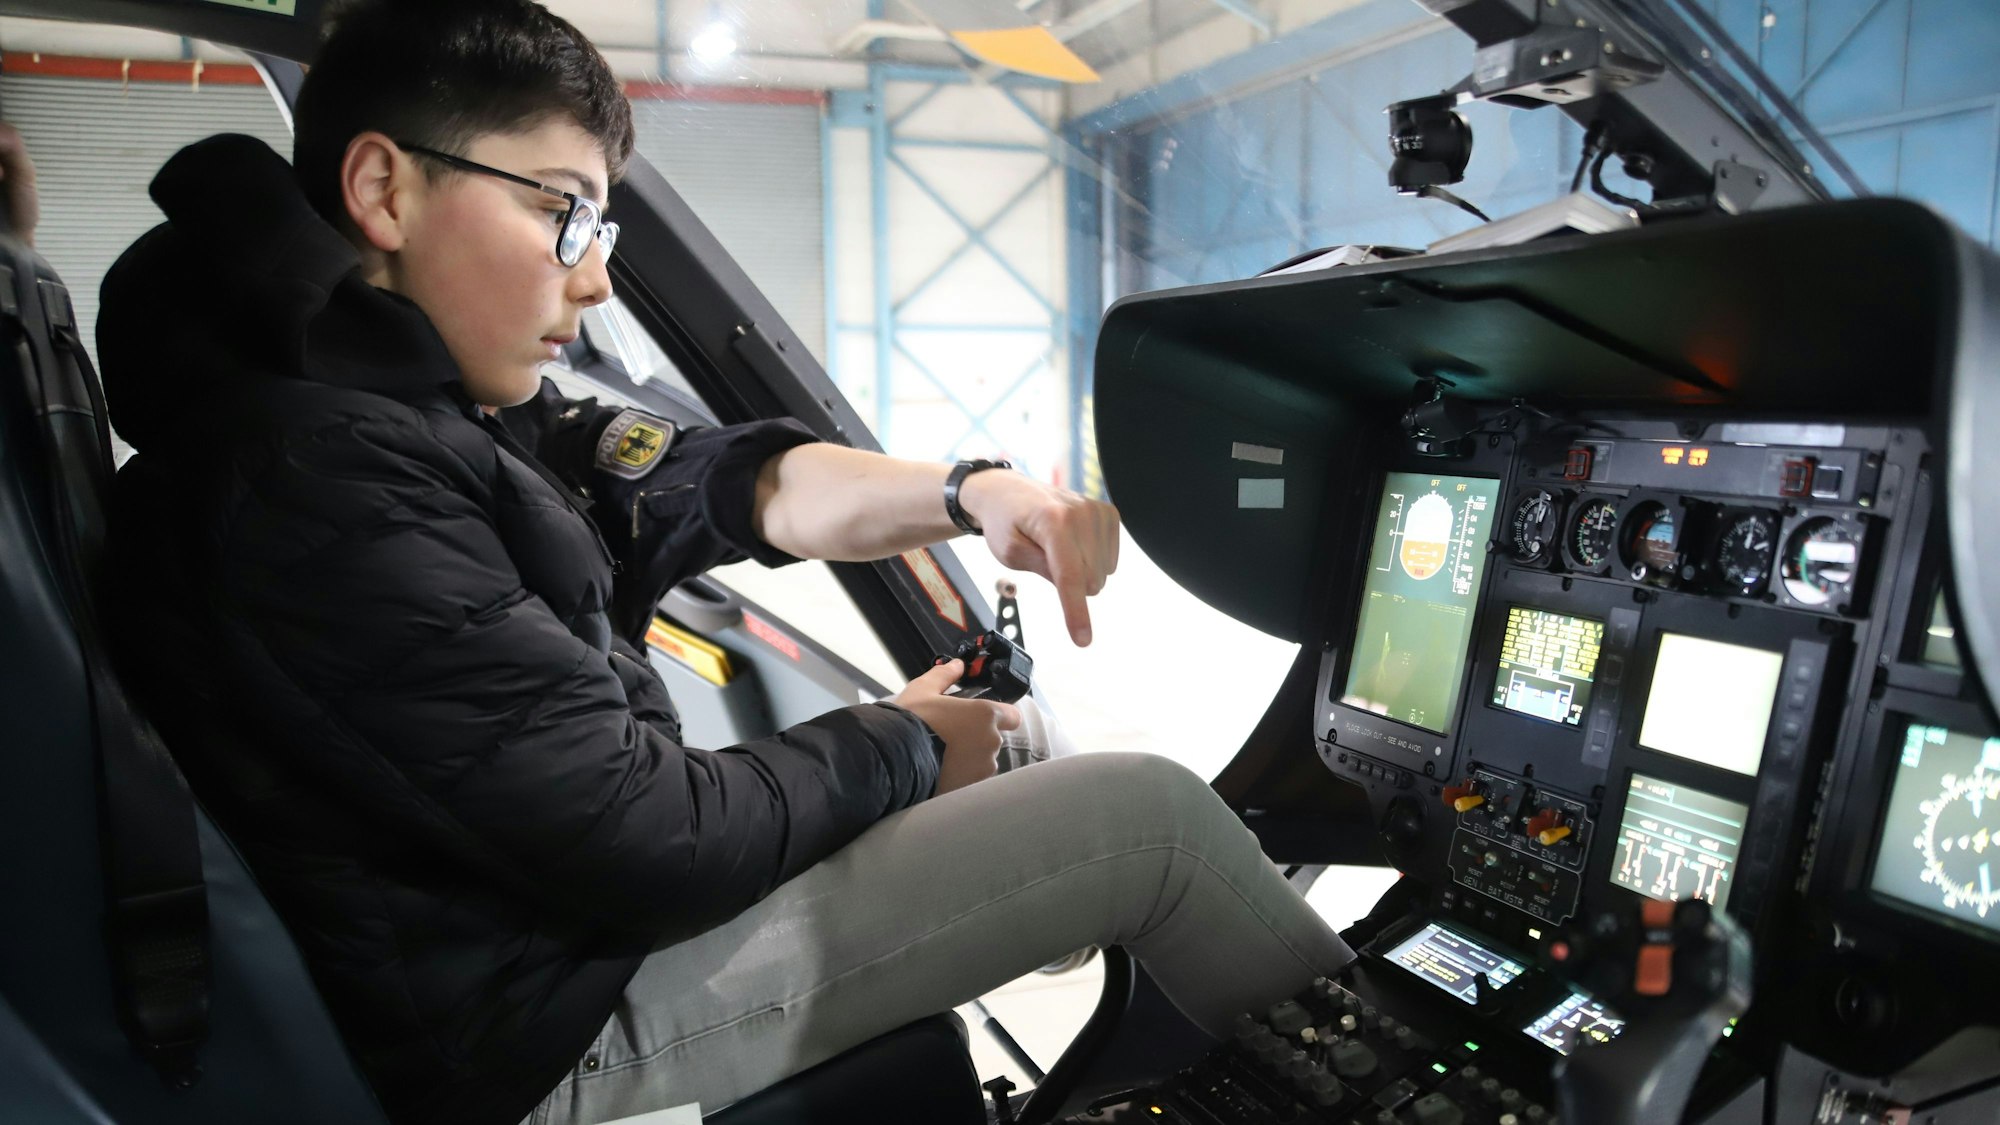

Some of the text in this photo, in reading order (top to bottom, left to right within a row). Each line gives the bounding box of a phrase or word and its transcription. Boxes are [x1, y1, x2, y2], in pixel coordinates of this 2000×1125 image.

[600, 413, 637, 464] POLIZEI
[1456, 483, 1467, 492] OFF
[1387, 735, 1397, 745] SEE
[1397, 739, 1408, 749] AND
[1408, 743, 1422, 753] AVOID
[1473, 823, 1489, 836] ENG
[1540, 849, 1557, 862] ENG
[1463, 875, 1479, 888] GEN
[1487, 885, 1524, 906] BAT MSTR
[1527, 903, 1545, 916] GEN
